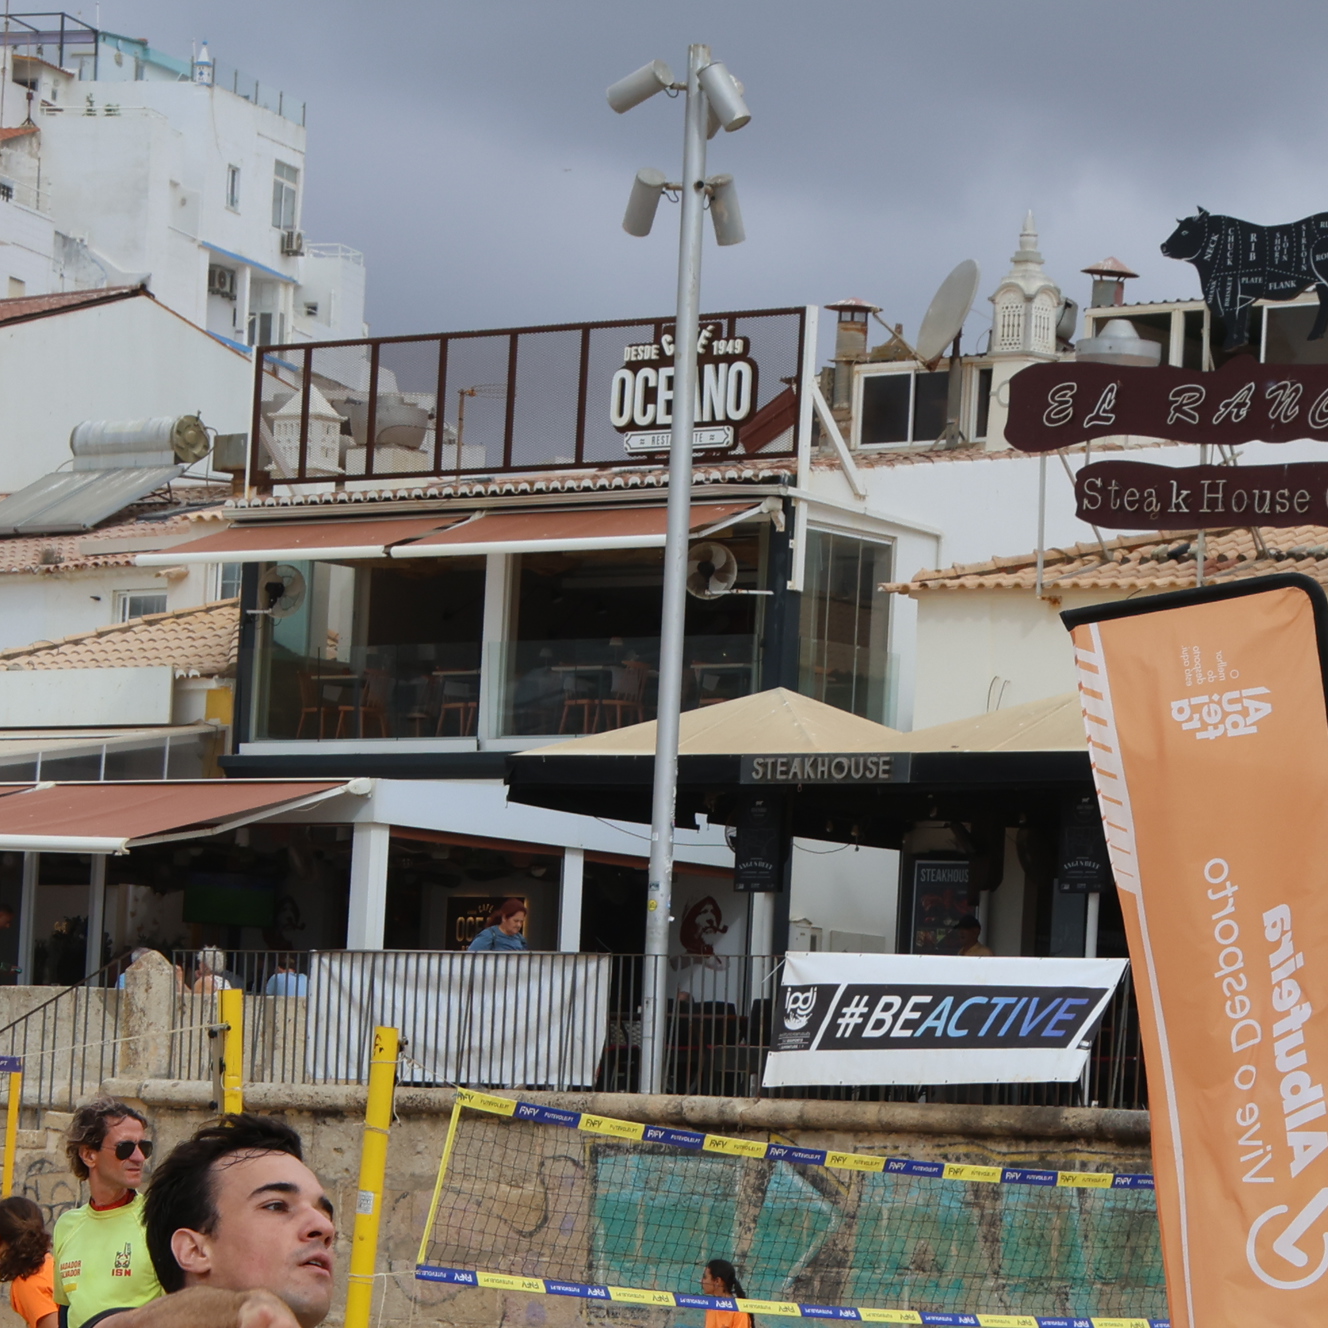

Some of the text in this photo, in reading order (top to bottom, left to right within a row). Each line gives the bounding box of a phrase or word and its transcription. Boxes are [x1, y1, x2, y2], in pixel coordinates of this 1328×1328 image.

[1203, 233, 1219, 261] NECK
[1249, 233, 1257, 261] RIB
[1268, 280, 1297, 291] FLANK
[624, 325, 743, 361] DESDE CÉ 1949
[610, 361, 752, 427] OCENO
[1043, 382, 1117, 428] EL
[1082, 476, 1191, 516] Steak
[1200, 479, 1310, 515] House
[751, 756, 891, 780] STEAKHOUSE
[920, 868, 970, 883] STEAKHOUS
[785, 986, 1090, 1038] ipdj #BEACTIVE
[112, 1268, 131, 1276] ISN
